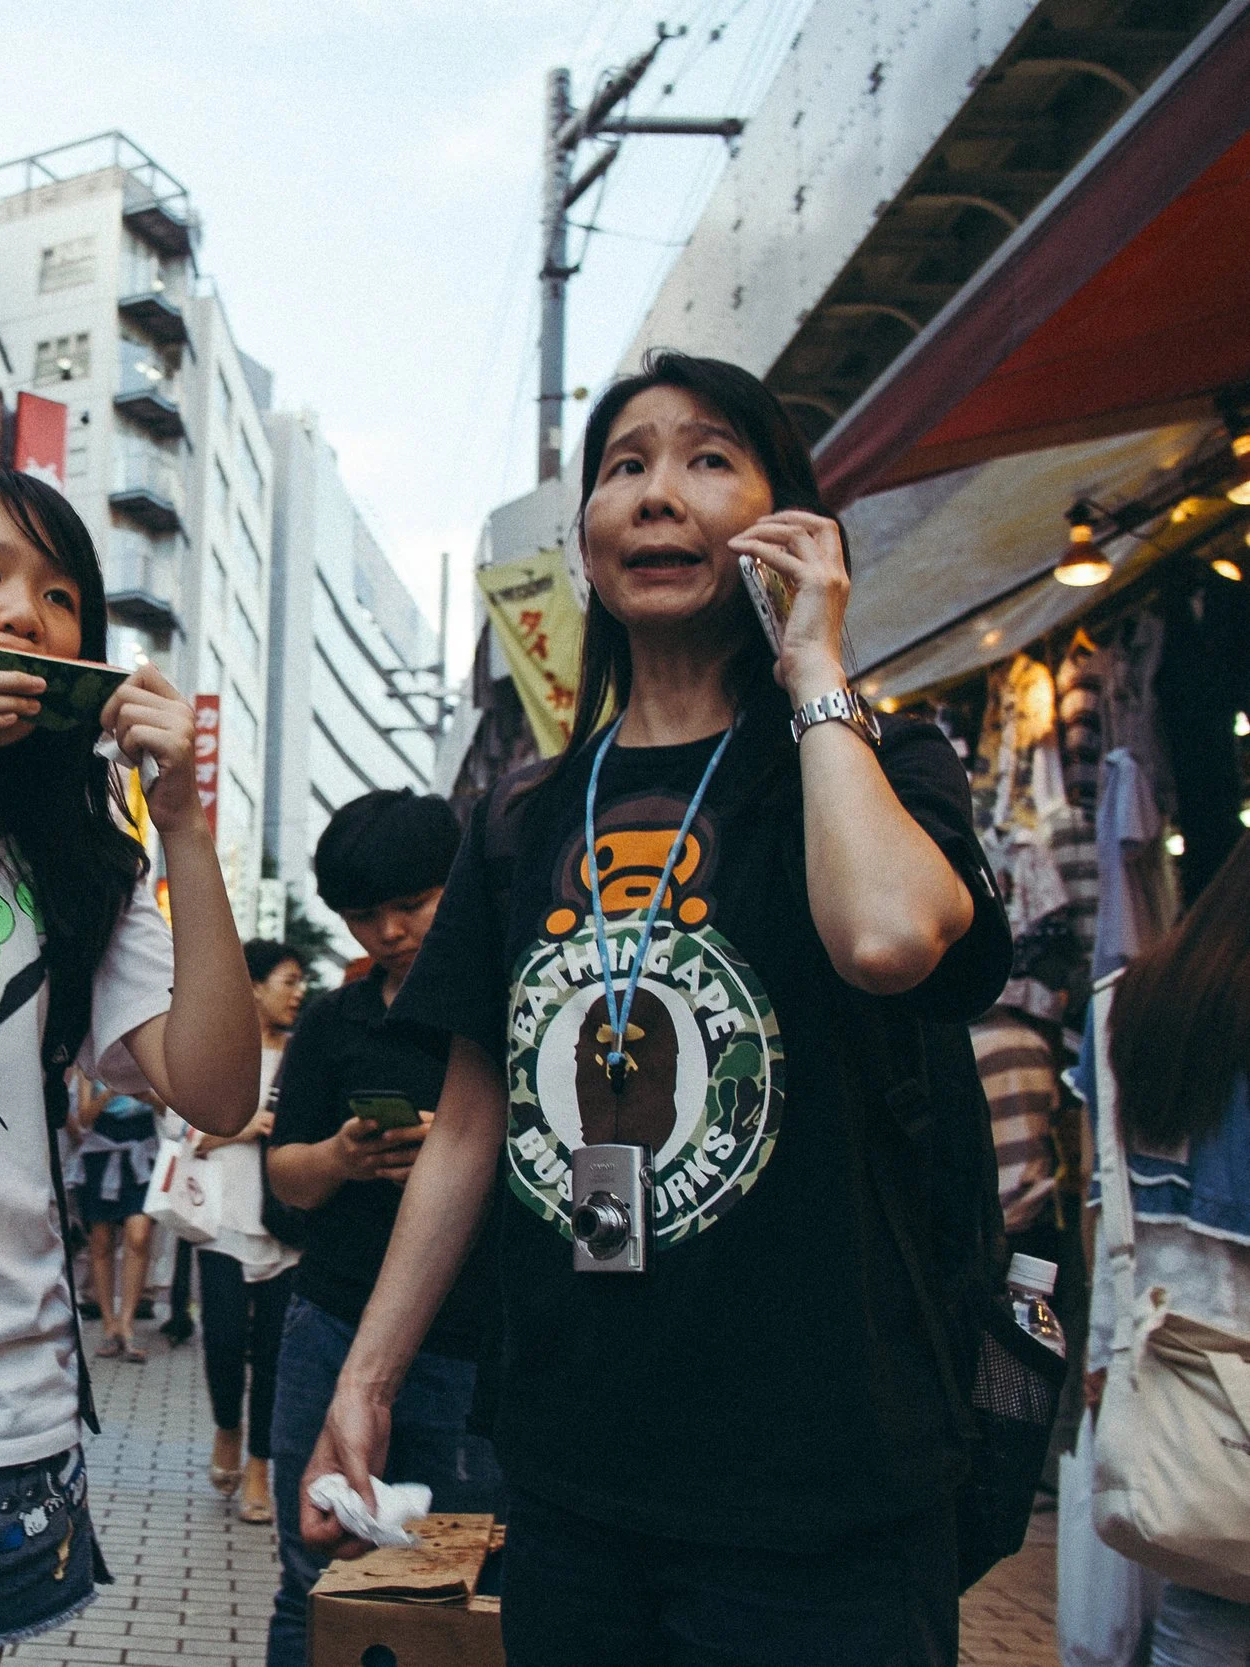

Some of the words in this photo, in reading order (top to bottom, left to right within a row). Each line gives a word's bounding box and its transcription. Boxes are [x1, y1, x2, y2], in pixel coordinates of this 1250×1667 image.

[513, 937, 670, 1047] BATHING
[671, 954, 746, 1042] APE
[515, 1126, 574, 1202] BUS
[654, 1125, 737, 1219] ORKS
